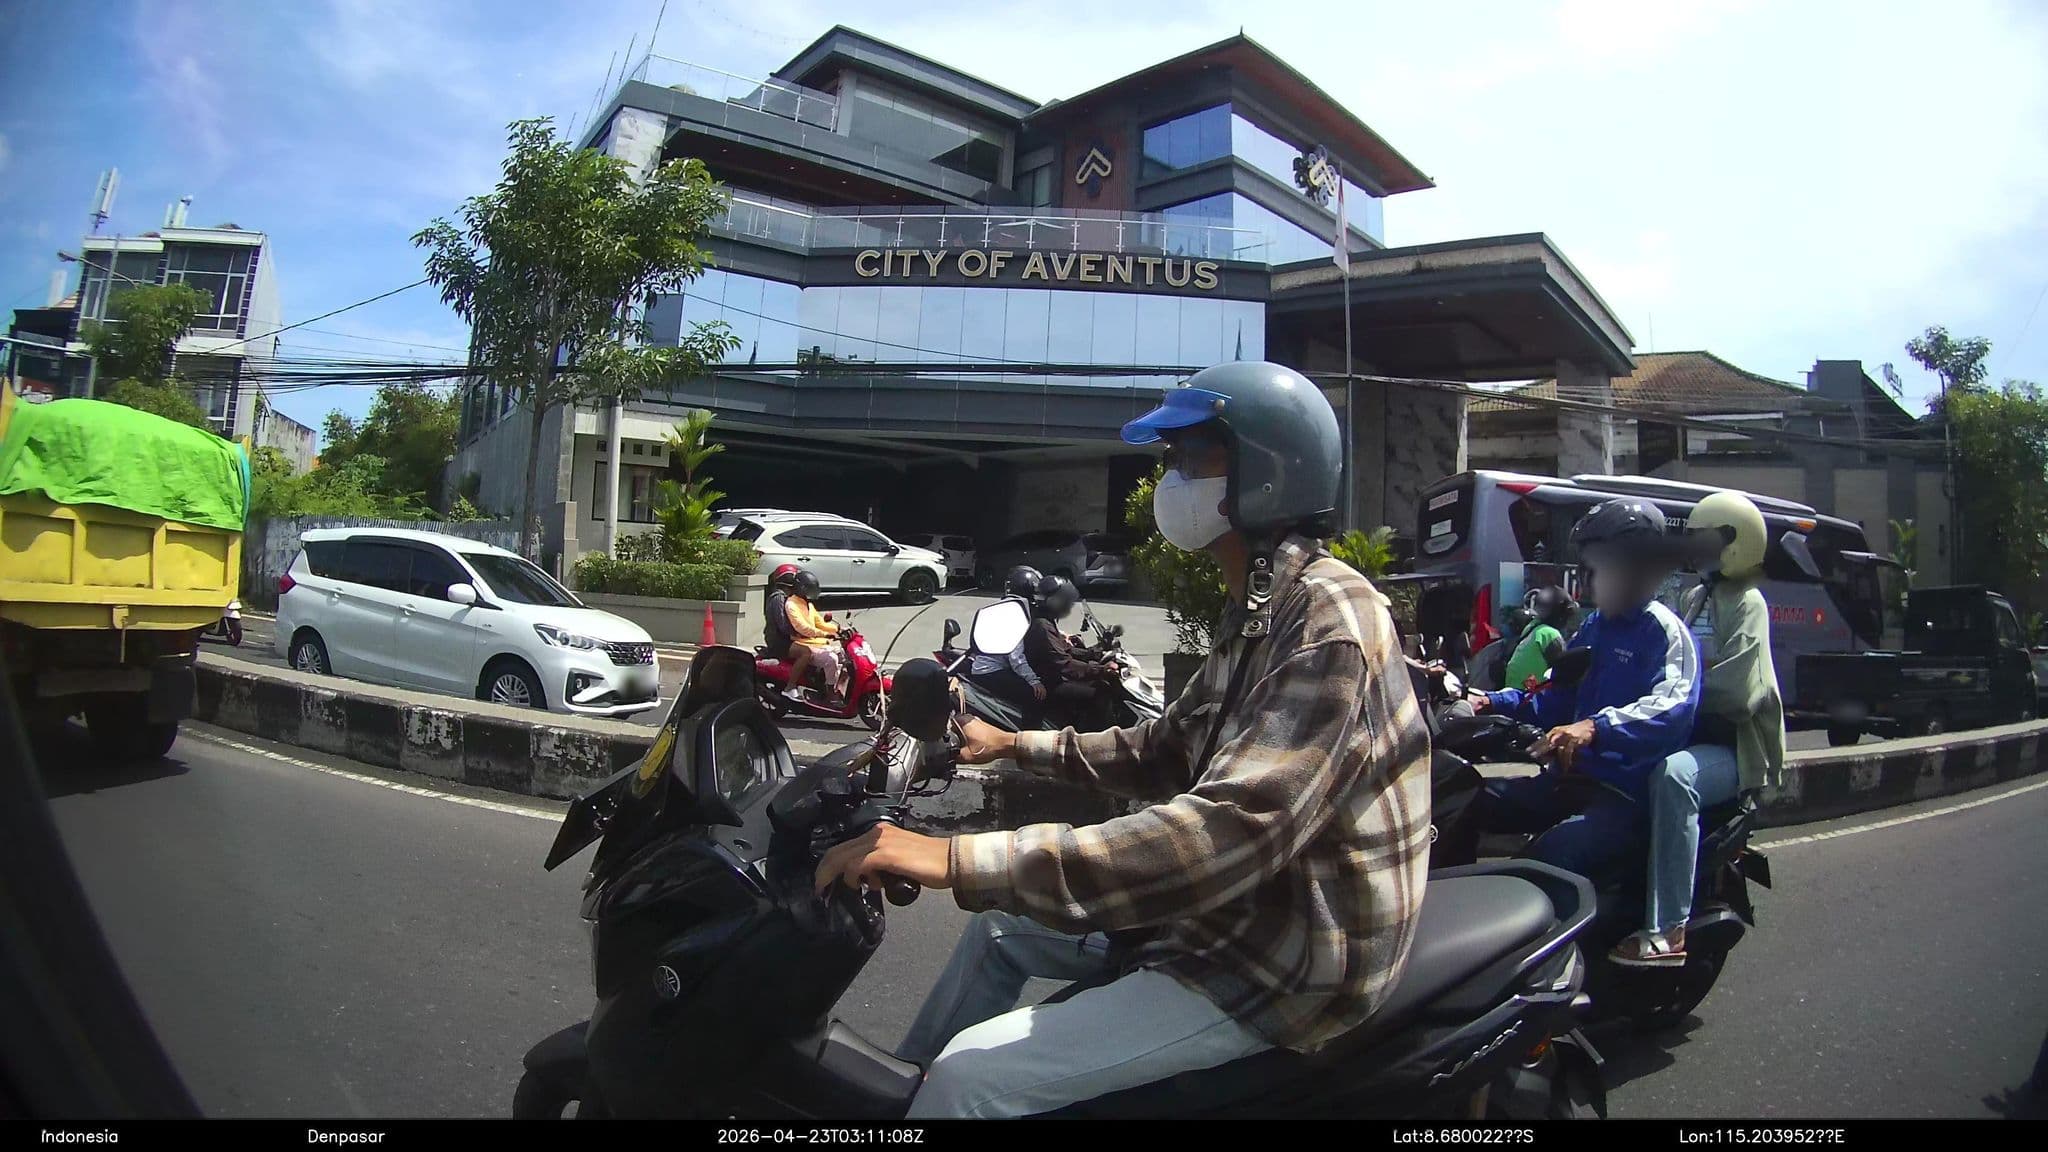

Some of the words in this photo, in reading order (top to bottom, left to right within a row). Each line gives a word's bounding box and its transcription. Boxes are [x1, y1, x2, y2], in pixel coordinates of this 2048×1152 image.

[854, 249, 948, 278] CITY
[957, 249, 1014, 279] OF
[1021, 251, 1220, 290] AVENTUS
